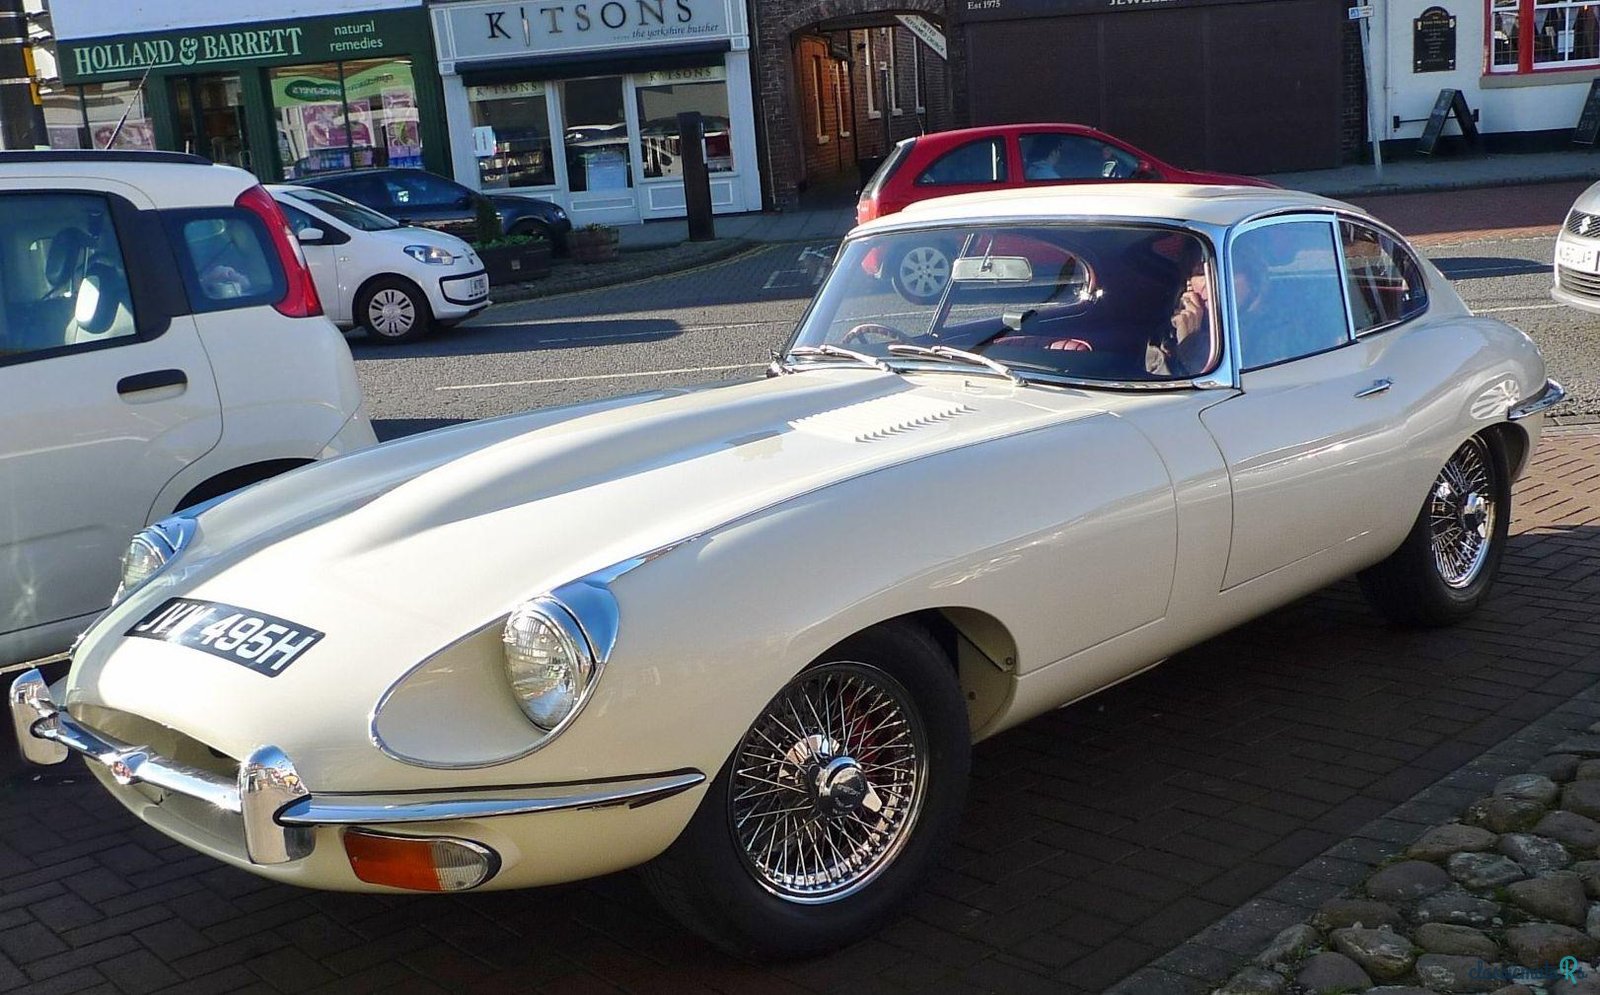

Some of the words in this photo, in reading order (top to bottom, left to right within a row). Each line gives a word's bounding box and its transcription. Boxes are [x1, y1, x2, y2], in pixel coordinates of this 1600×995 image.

[967, 1, 981, 9] Est
[334, 20, 375, 36] natural
[632, 28, 645, 38] the
[647, 26, 685, 40] yorkshire
[687, 23, 719, 34] butcher
[73, 39, 174, 75] HOLLAND
[179, 36, 199, 66] &
[203, 27, 303, 59] BARRETT
[330, 37, 383, 52] remedies
[200, 612, 315, 671] 495H
